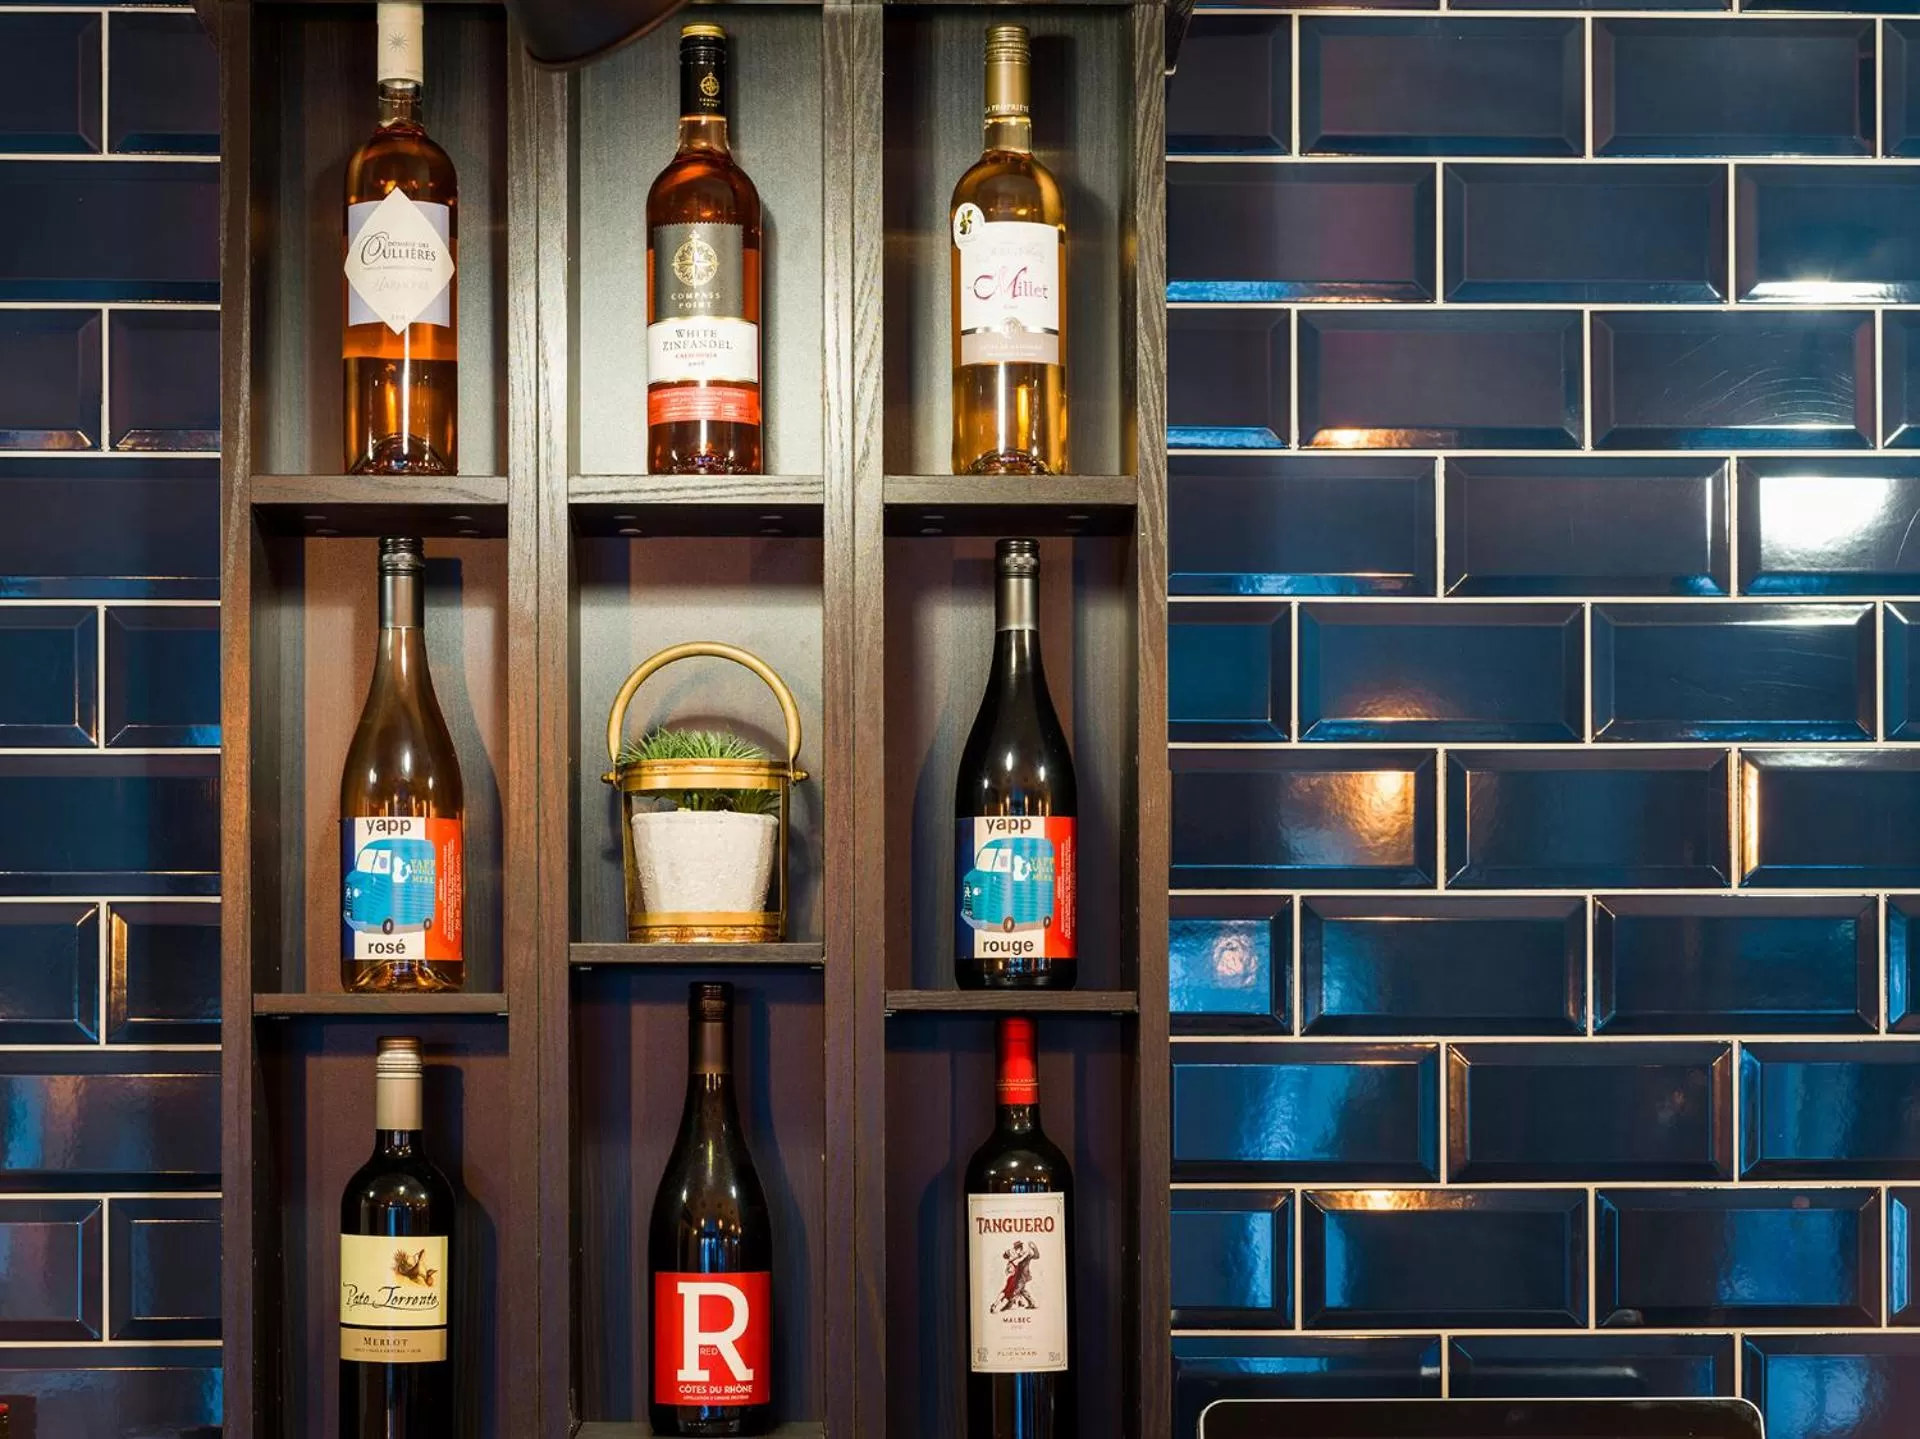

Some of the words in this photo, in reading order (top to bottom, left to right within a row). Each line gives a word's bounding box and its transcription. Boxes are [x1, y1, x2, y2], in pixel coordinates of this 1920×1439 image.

[972, 265, 1048, 301] Millet
[670, 292, 721, 300] COMPASS
[678, 301, 712, 309] POINT
[675, 328, 718, 338] WHITE
[662, 339, 733, 352] ZINFANDEL
[366, 818, 412, 836] yapp
[986, 817, 1032, 834] yapp
[368, 939, 406, 955] rosé
[983, 940, 1034, 956] rouge
[976, 1215, 1055, 1235] TANGUERO
[1003, 1316, 1031, 1324] MALBEC
[677, 1281, 754, 1382] R
[363, 1336, 408, 1347] MERLOT
[700, 1347, 719, 1356] RED
[678, 1384, 707, 1394] CÔTES
[709, 1385, 722, 1394] DU
[723, 1384, 753, 1394] RHÔNE
